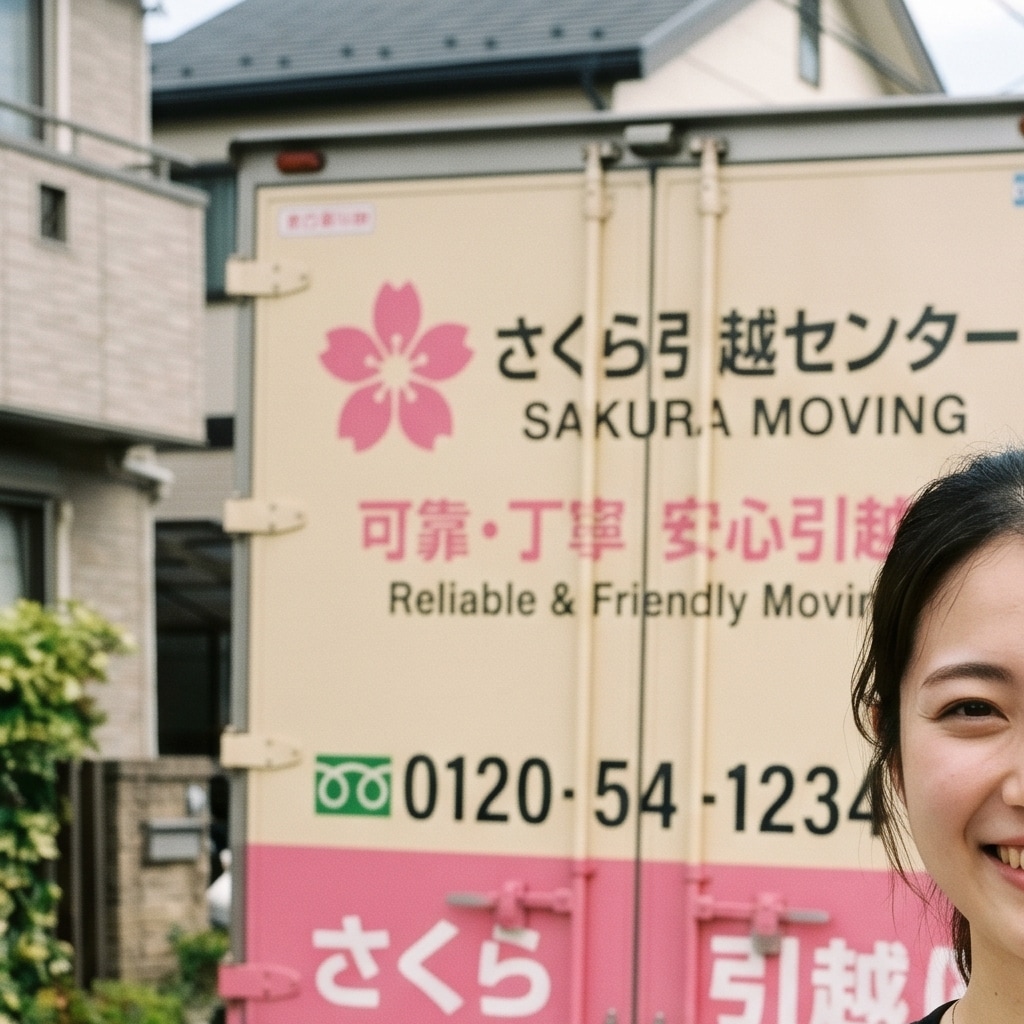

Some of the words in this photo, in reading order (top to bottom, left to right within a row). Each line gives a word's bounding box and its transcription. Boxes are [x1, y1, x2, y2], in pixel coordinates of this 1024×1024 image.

[523, 399, 730, 440] SAKURA
[753, 395, 967, 437] MOVING
[389, 581, 537, 616] Reliable
[551, 582, 575, 616] &
[593, 582, 747, 627] Friendly
[312, 915, 552, 1018] さくら
